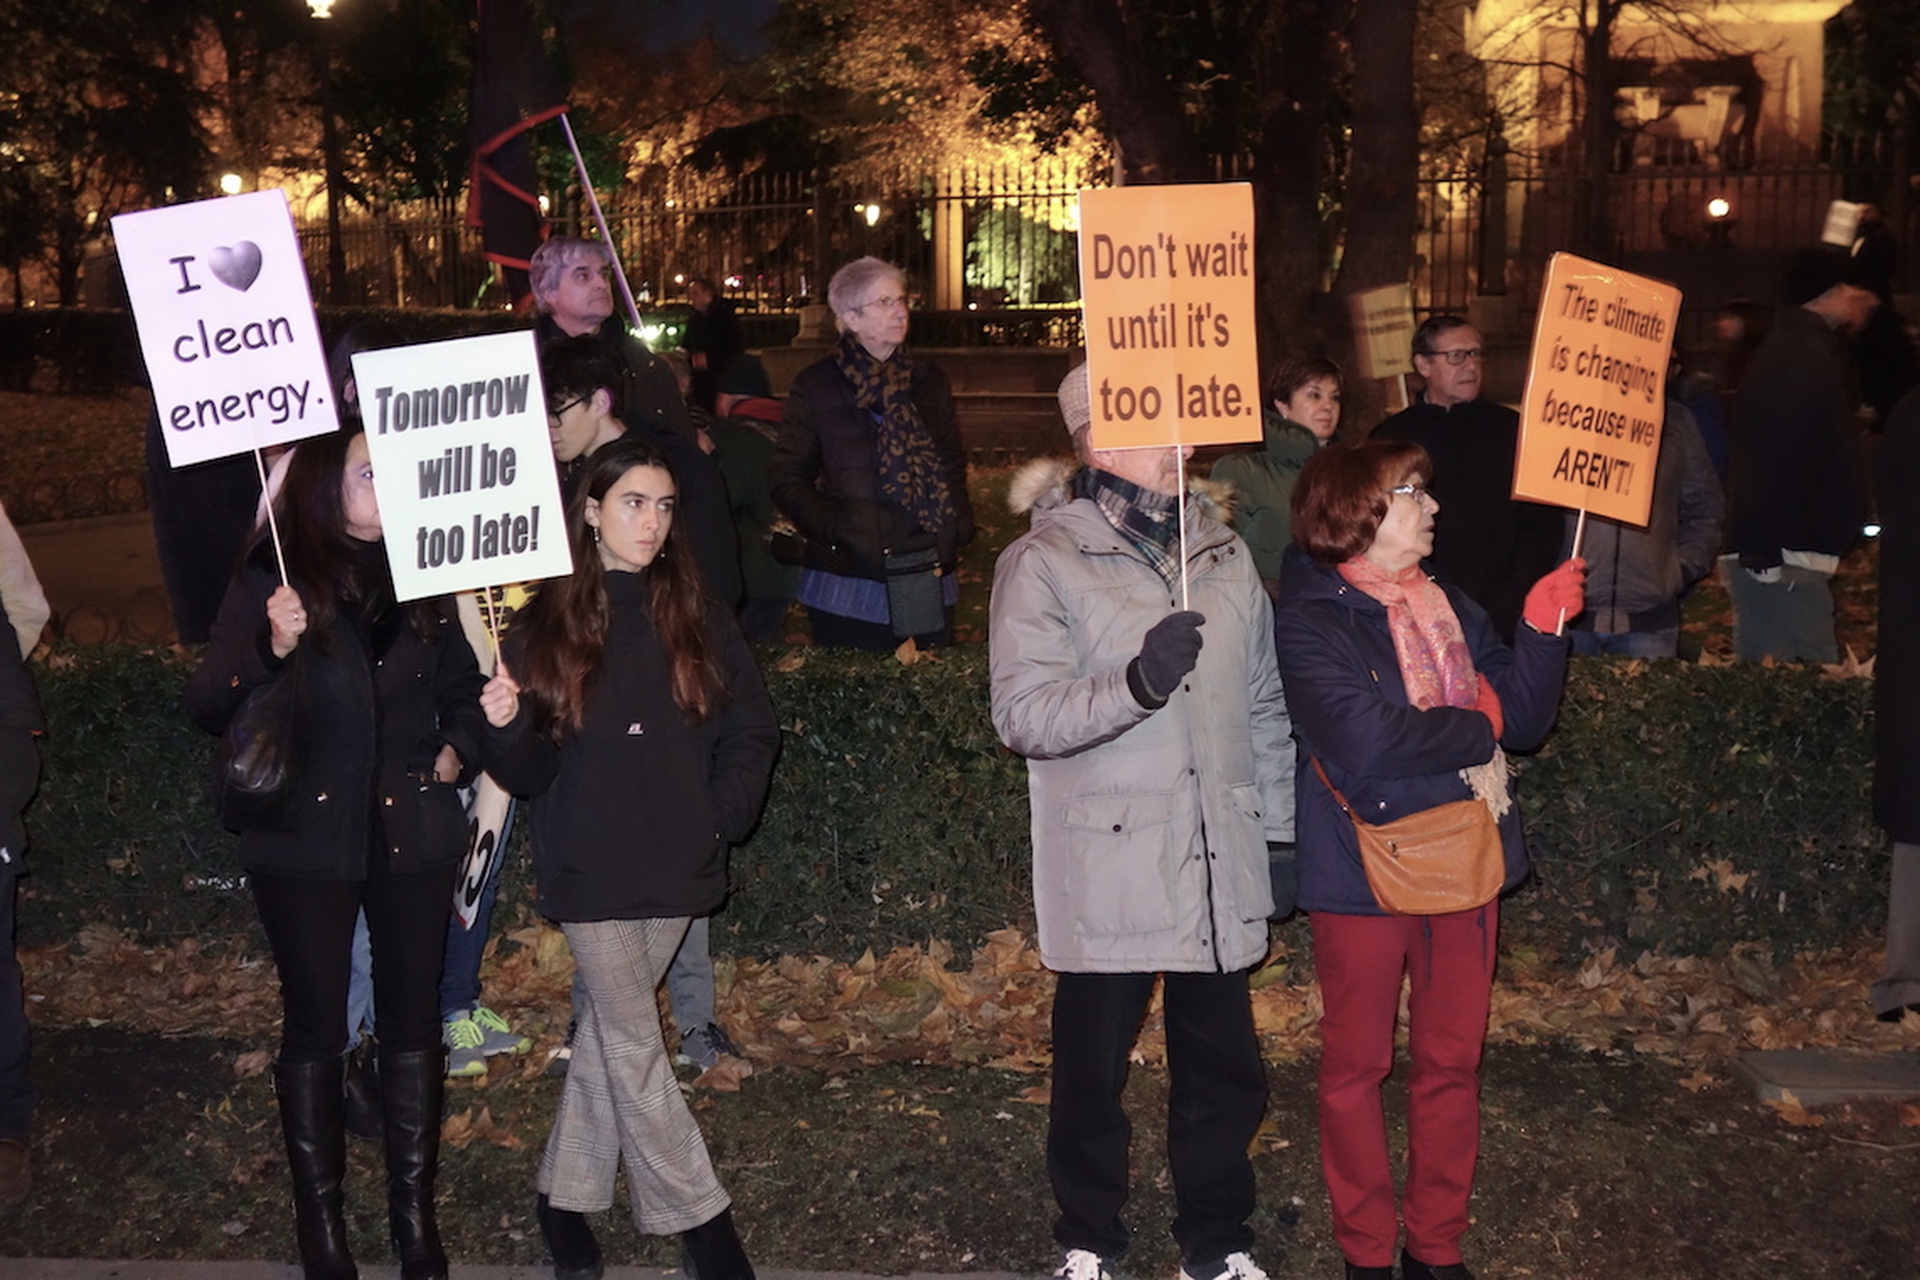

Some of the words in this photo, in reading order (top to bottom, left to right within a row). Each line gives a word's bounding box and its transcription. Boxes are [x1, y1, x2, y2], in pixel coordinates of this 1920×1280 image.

[169, 255, 201, 295] I
[1093, 233, 1177, 280] Don't
[1186, 231, 1248, 277] wait
[173, 316, 294, 363] clean
[1108, 303, 1177, 350] until
[1188, 302, 1230, 348] it's
[1560, 283, 1599, 323] The
[1603, 297, 1666, 343] climate
[1550, 335, 1571, 372] is
[1576, 344, 1659, 404] changing
[170, 380, 324, 431] energy.
[375, 373, 530, 435] Tomorrow
[1100, 377, 1161, 422] too
[1177, 373, 1252, 418] late.
[1541, 388, 1627, 439] because
[1630, 416, 1655, 448] we
[417, 445, 472, 499] will
[480, 443, 516, 489] be
[416, 524, 464, 570] too
[472, 505, 540, 561] late!
